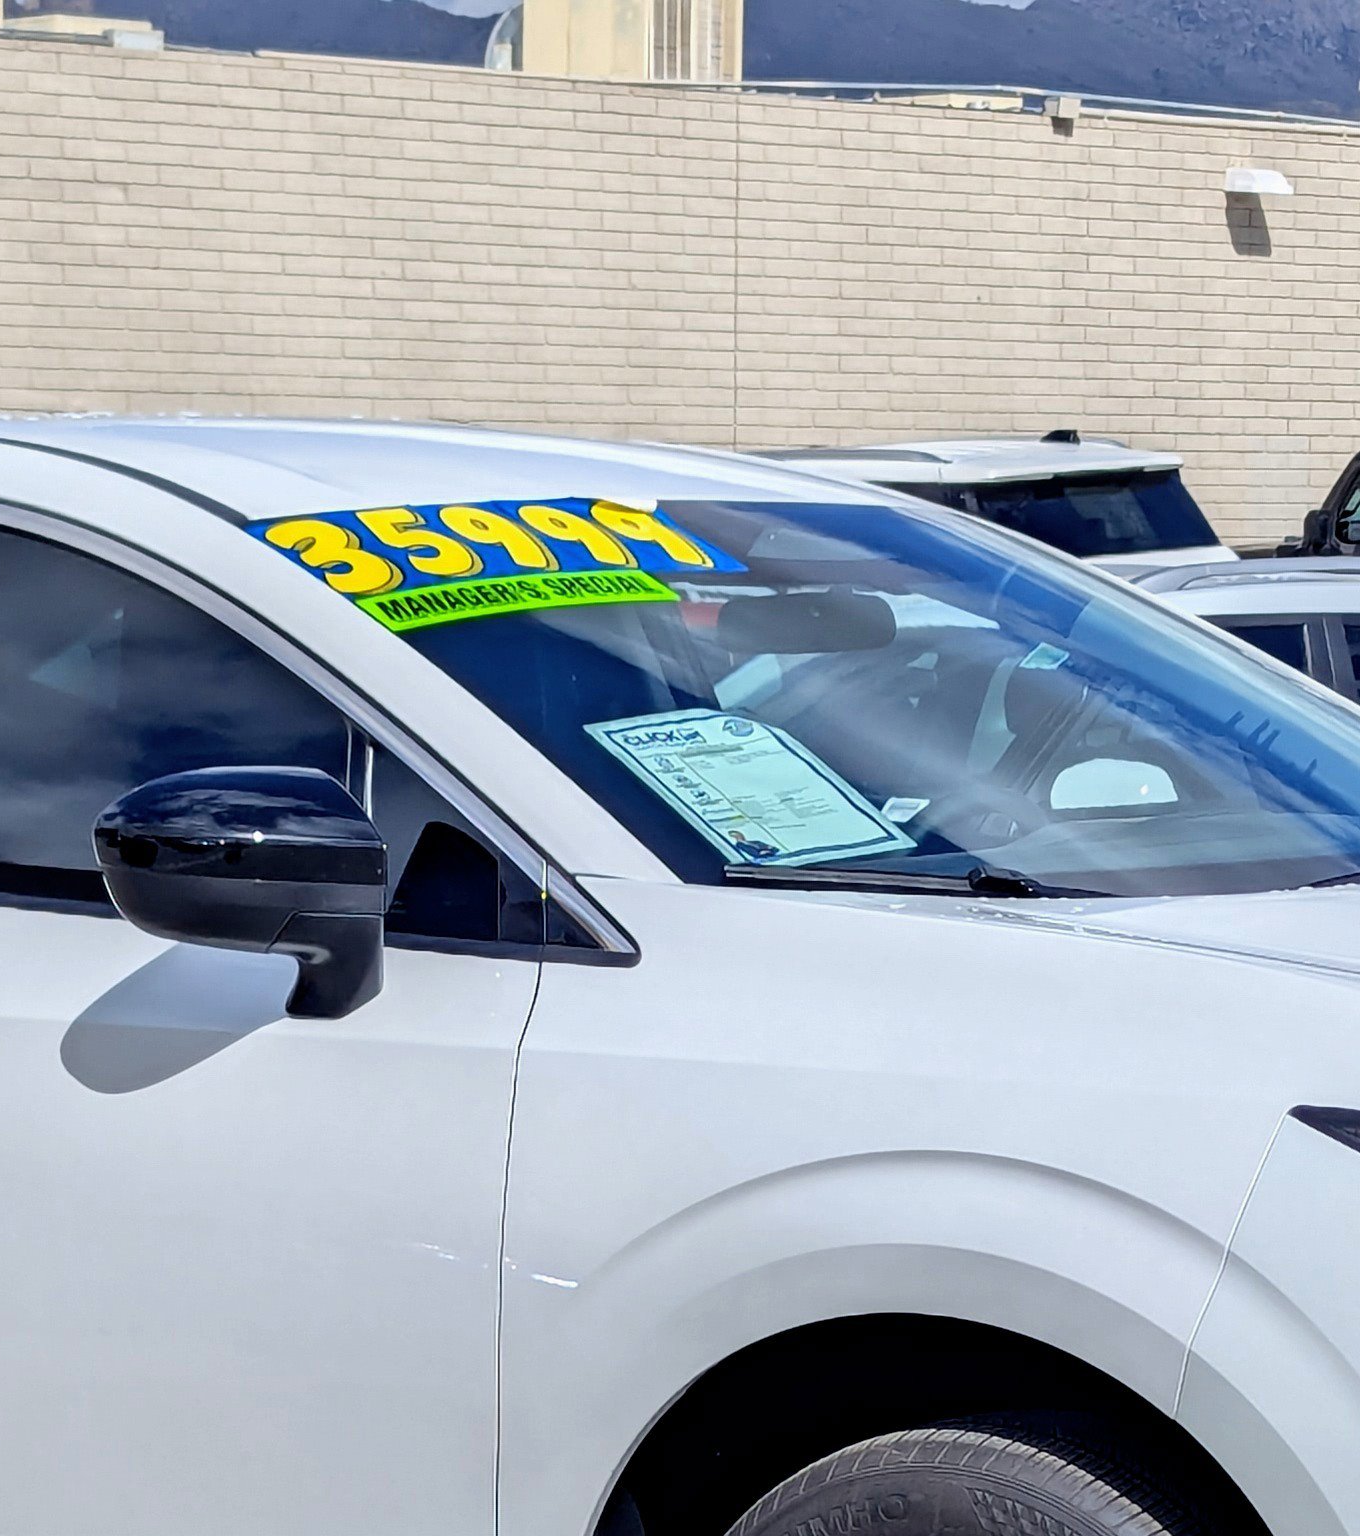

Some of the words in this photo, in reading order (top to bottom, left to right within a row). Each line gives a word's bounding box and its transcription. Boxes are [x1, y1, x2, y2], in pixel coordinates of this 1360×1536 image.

[265, 500, 714, 594] 35999
[377, 580, 540, 621] MANAGER'S
[543, 575, 652, 597] SPECIAL
